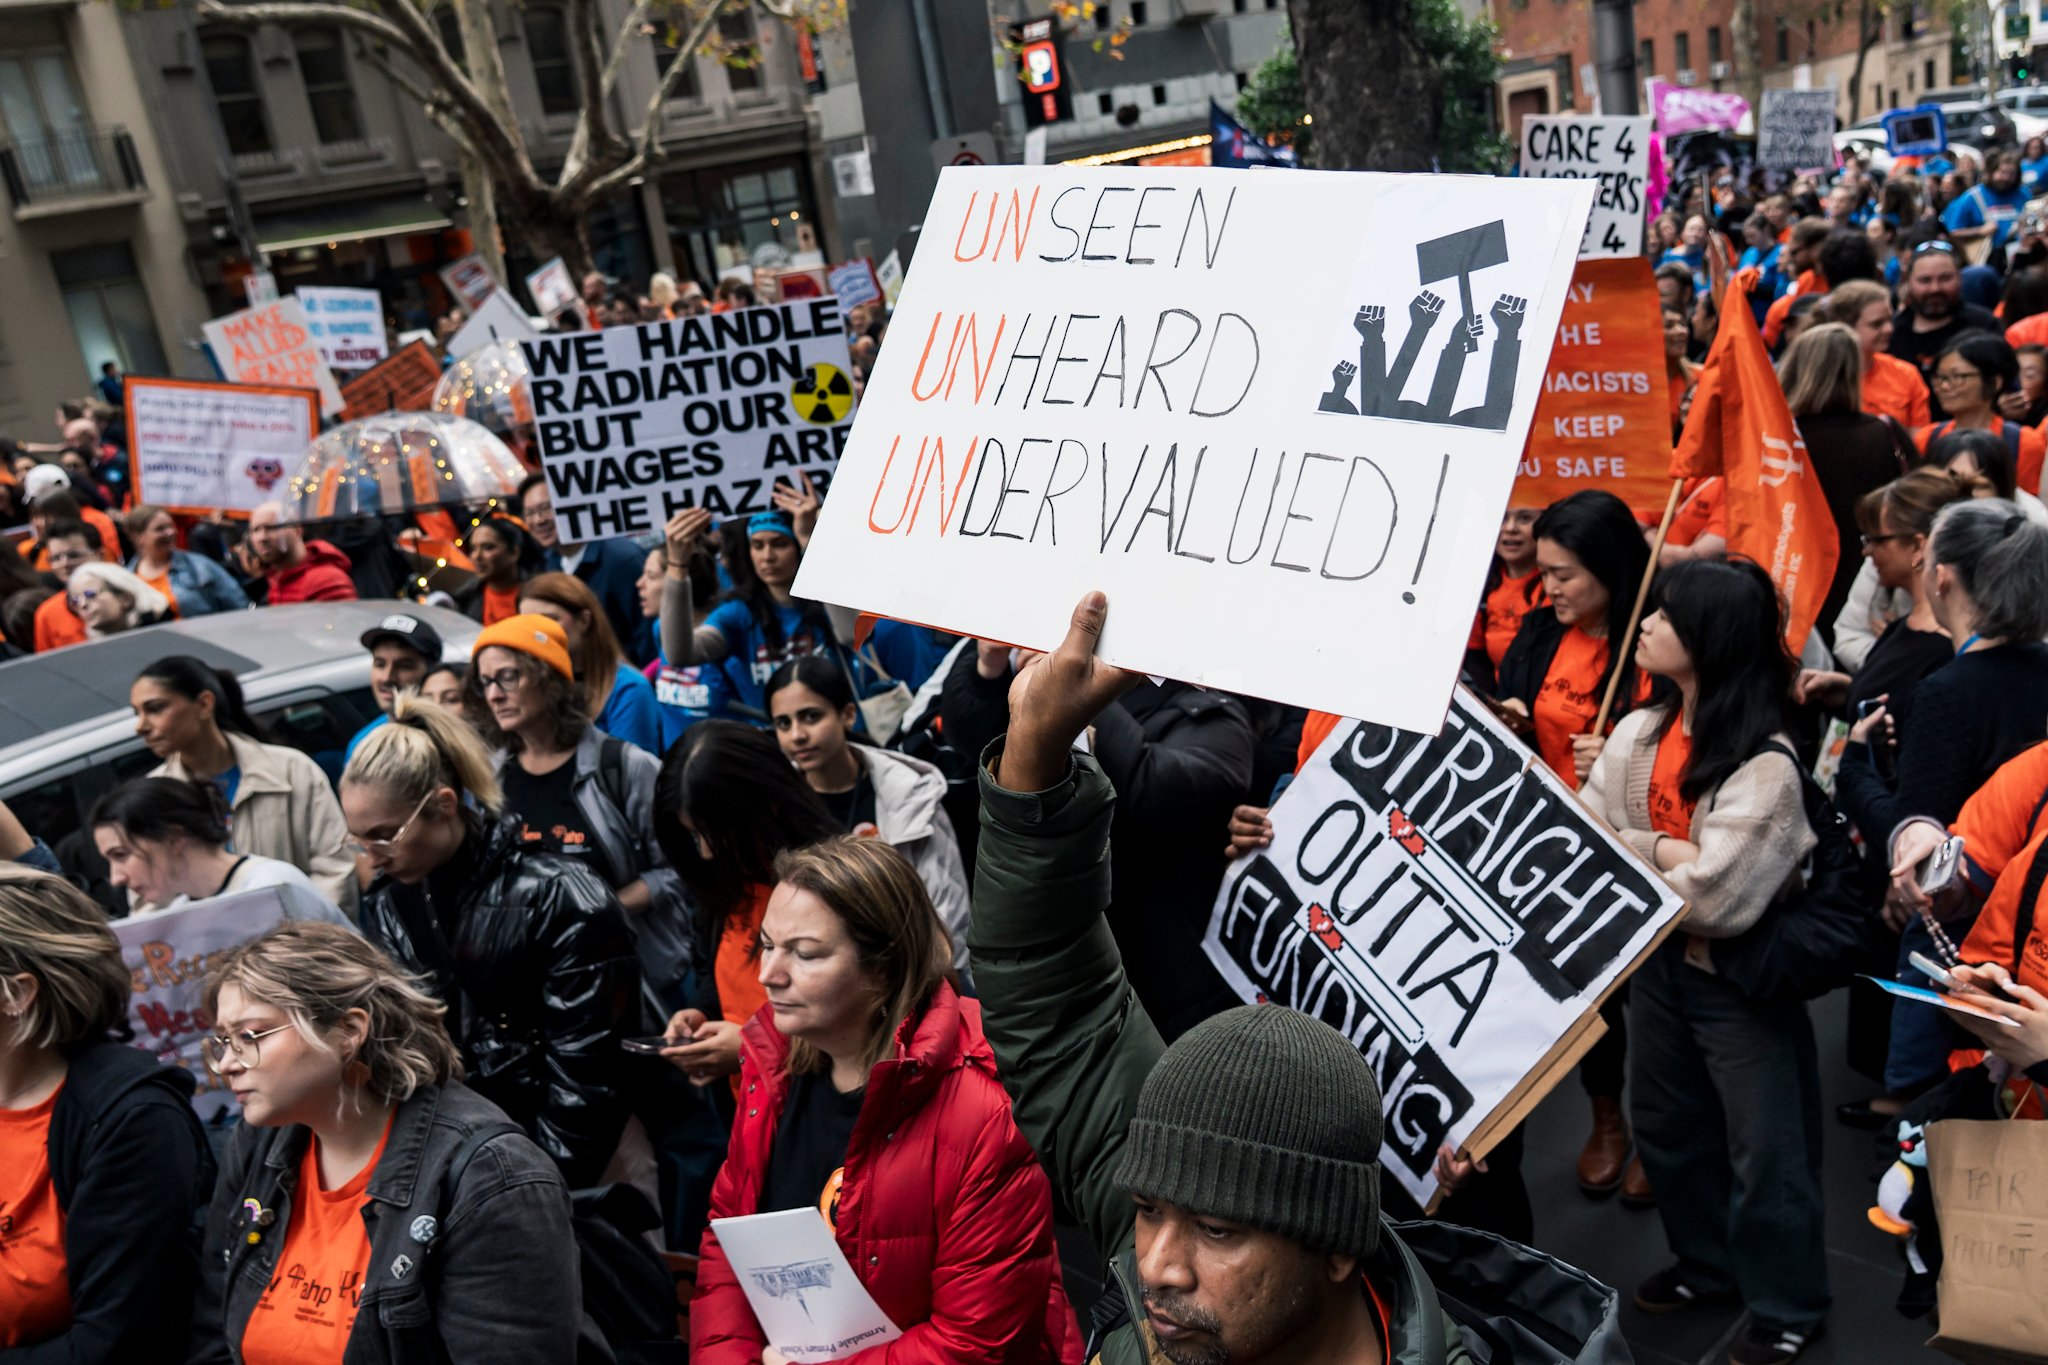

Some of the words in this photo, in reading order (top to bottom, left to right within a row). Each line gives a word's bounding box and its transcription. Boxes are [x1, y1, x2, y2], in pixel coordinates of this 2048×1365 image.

[1528, 122, 1605, 163] CARE
[1615, 126, 1635, 164] 4
[954, 185, 1237, 269] UNSEEN
[1602, 222, 1626, 253] 4
[521, 333, 609, 377] WE
[636, 299, 843, 361] HANDLE
[911, 308, 1260, 418] UNHEARD
[530, 345, 802, 416] RADIATION
[539, 411, 642, 457] BUT
[682, 392, 791, 436] OUR
[1553, 415, 1625, 438] KEEP
[546, 440, 724, 498] WAGES
[1556, 456, 1626, 478] SAFE
[556, 496, 652, 540] THE
[867, 434, 1450, 605] UNDERVALUED!
[1299, 799, 1501, 1049] OUTTA
[300, 1279, 332, 1308] ahp
[838, 1325, 887, 1349] Armadale
